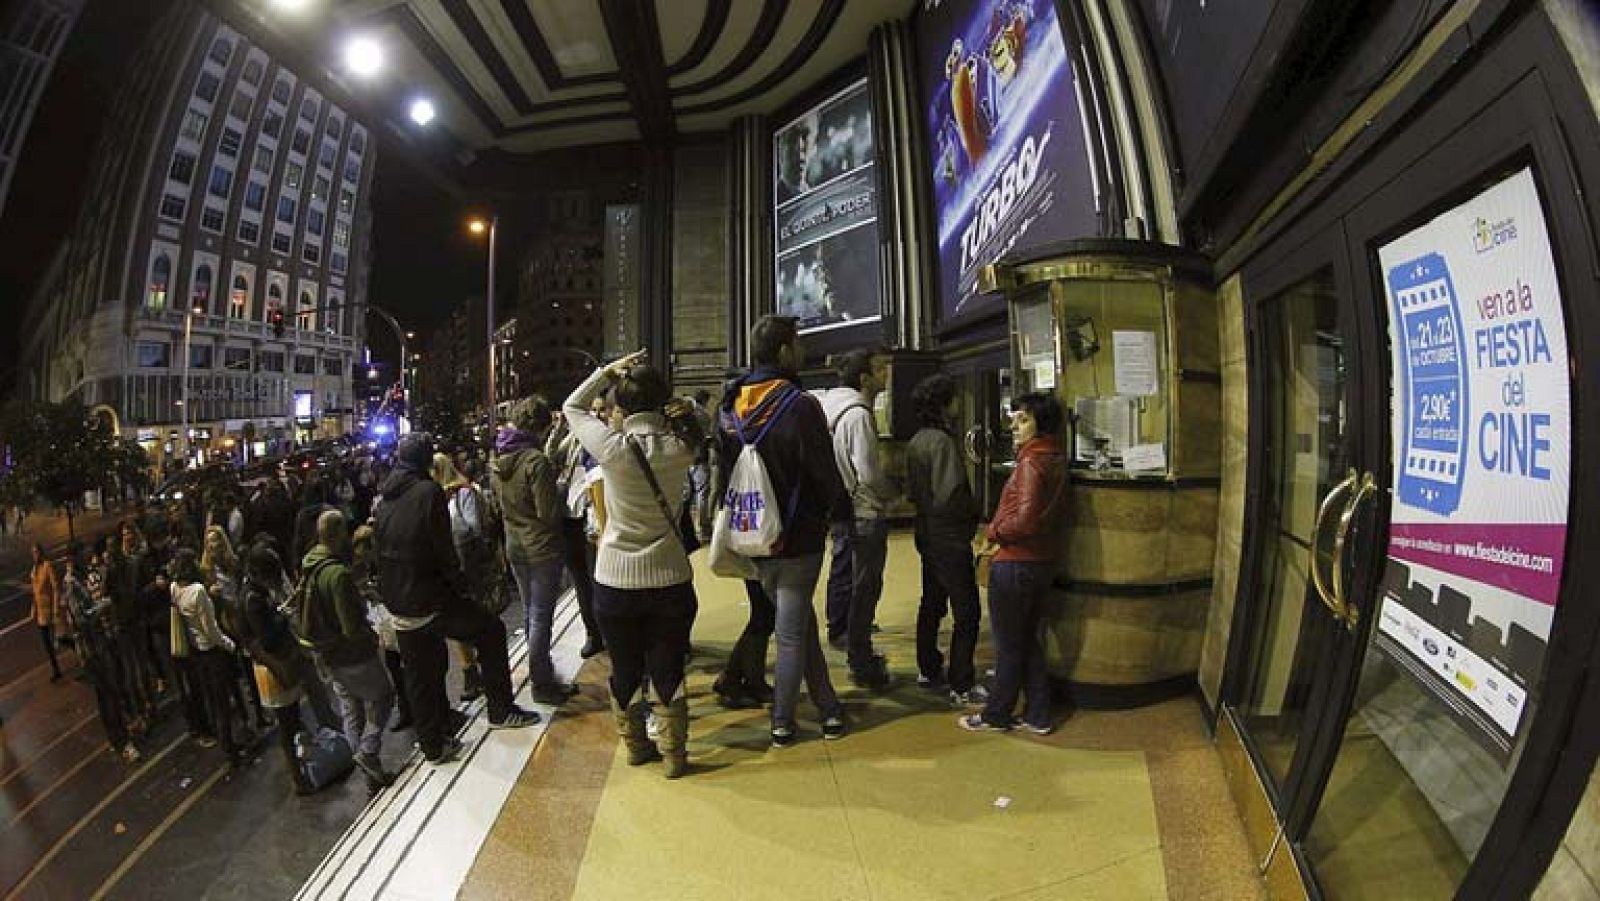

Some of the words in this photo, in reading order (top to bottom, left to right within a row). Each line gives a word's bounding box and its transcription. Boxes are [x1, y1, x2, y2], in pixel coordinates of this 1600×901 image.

[959, 130, 1050, 275] TURBO
[1477, 293, 1504, 319] ven
[1506, 289, 1517, 315] a
[1517, 277, 1533, 311] la
[1475, 318, 1552, 368] FIESTA
[1502, 371, 1525, 407] del
[1479, 412, 1550, 480] CINE
